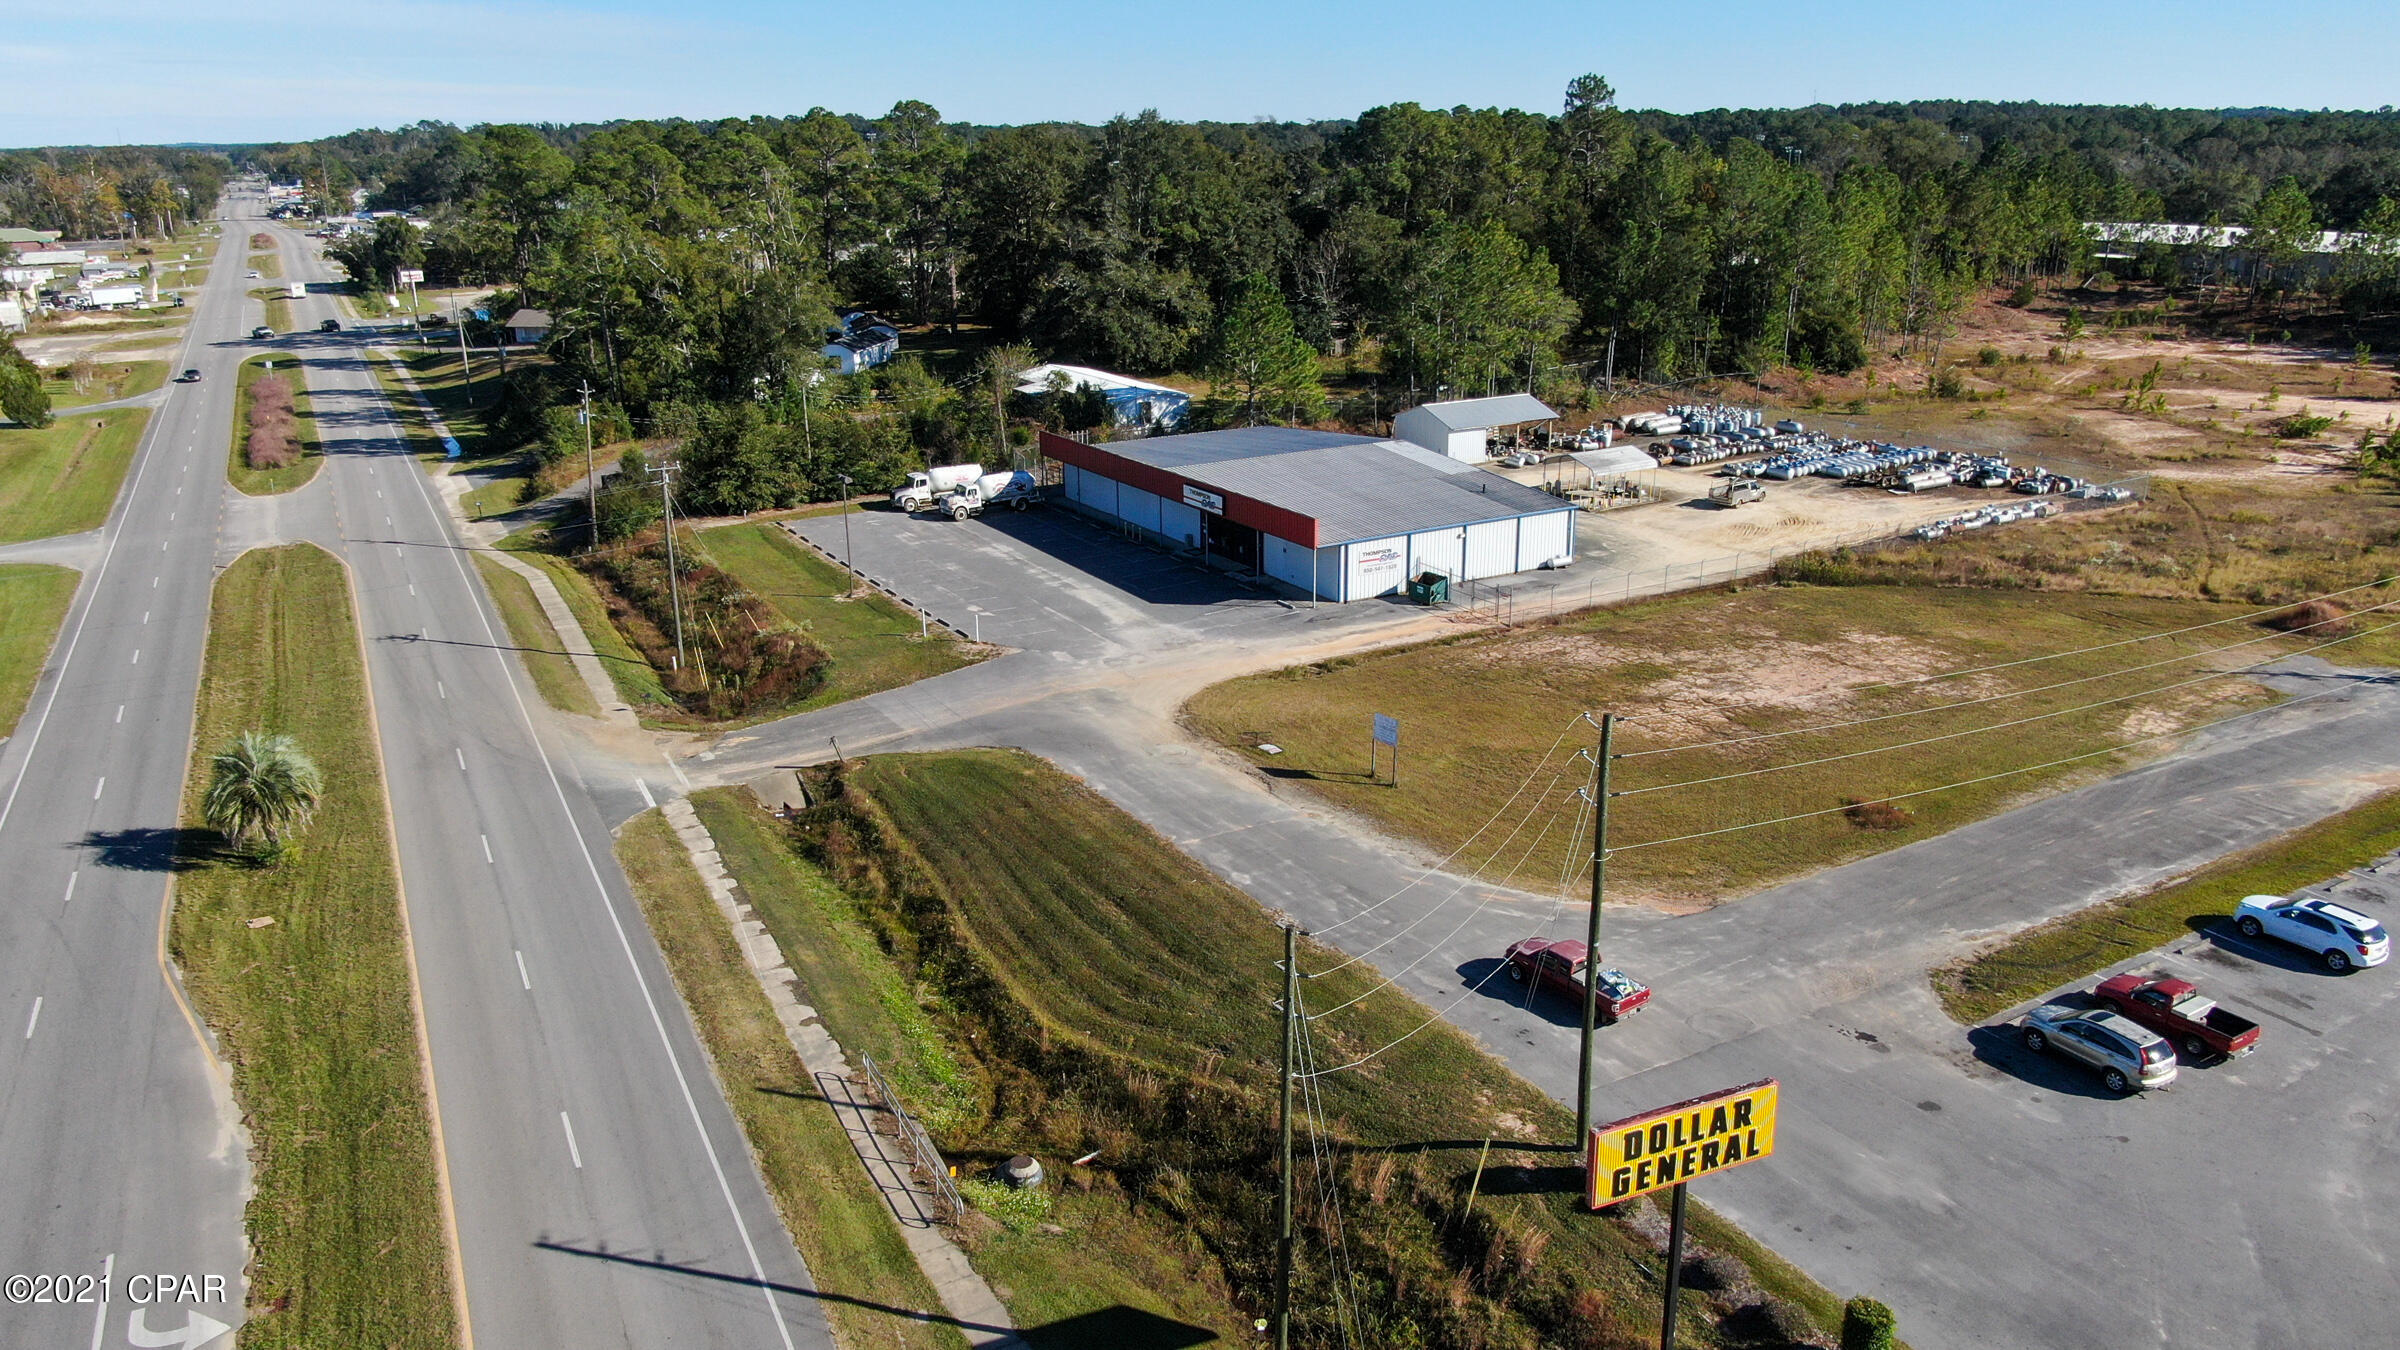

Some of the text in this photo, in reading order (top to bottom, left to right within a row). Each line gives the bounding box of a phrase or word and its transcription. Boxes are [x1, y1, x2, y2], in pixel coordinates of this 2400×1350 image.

[1362, 549, 1392, 557] THOMPSON
[1623, 1098, 1752, 1162] DOLLAR
[1611, 1129, 1760, 1198] GENERAL
